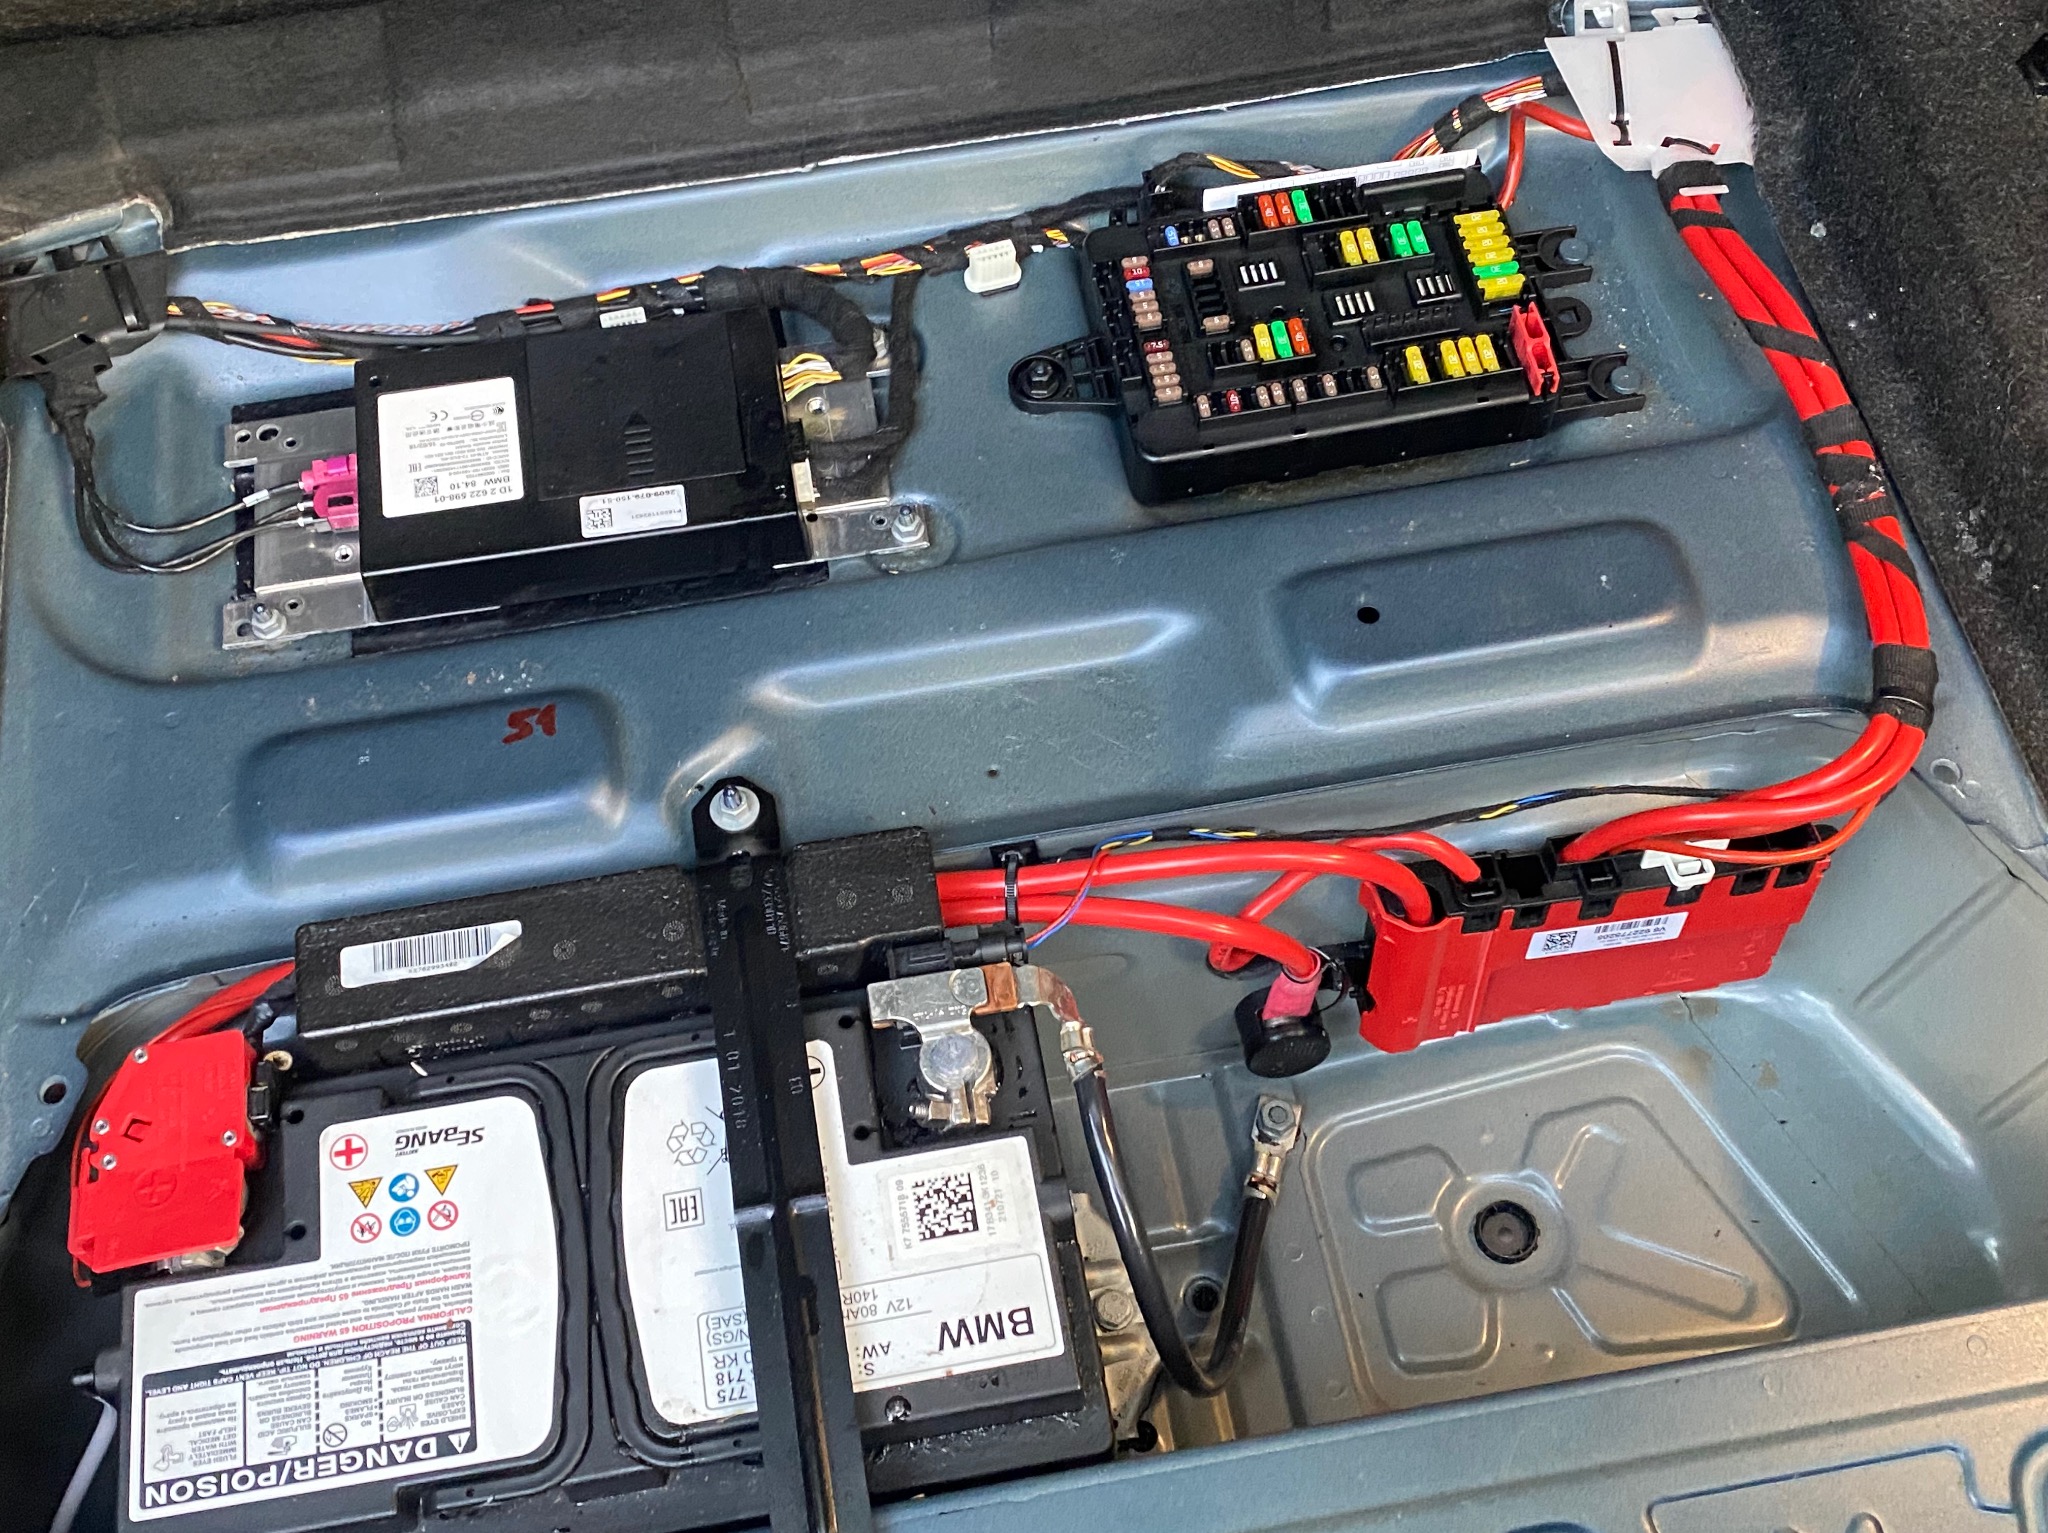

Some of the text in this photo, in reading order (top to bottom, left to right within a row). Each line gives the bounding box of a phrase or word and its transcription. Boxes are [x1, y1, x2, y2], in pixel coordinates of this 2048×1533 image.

[449, 475, 510, 490] BMW 84.10
[469, 489, 487, 497] 622
[490, 487, 496, 495] 2
[433, 492, 466, 502] 598-01
[395, 1126, 484, 1150] SEBANG
[338, 1292, 348, 1300] 65
[885, 1297, 912, 1313] 12V
[417, 1305, 472, 1322] CALIFORNIA
[352, 1315, 414, 1333] PROPOSITION
[935, 1306, 1034, 1351] BMW
[293, 1329, 336, 1342] WARNING
[446, 1335, 466, 1345] KEEP
[401, 1344, 416, 1352] THE
[430, 1339, 445, 1348] OUT
[362, 1351, 372, 1359] OF
[374, 1346, 400, 1357] REACH
[854, 1340, 892, 1360] AW:
[309, 1360, 320, 1368] DO
[712, 1352, 738, 1369] KR
[292, 1362, 307, 1371] NOT
[857, 1361, 874, 1376] S:
[235, 1372, 254, 1381] VENT
[256, 1368, 275, 1377] KEEP
[714, 1368, 745, 1385] 718
[190, 1379, 210, 1389] TIGHT
[212, 1375, 233, 1385] CAPS
[172, 1383, 188, 1392] AND
[449, 1393, 464, 1401] CAN
[716, 1385, 745, 1402] 775
[344, 1404, 372, 1414] FLAMES
[296, 1416, 311, 1424] CAN
[344, 1411, 372, 1421] SPARKS
[218, 1425, 236, 1434] HELP
[191, 1439, 236, 1452] WITH WATER
[188, 1446, 236, 1460] IMMEDIATELY
[192, 1458, 210, 1466] EYES
[145, 1438, 437, 1509] DANGER/POISON
